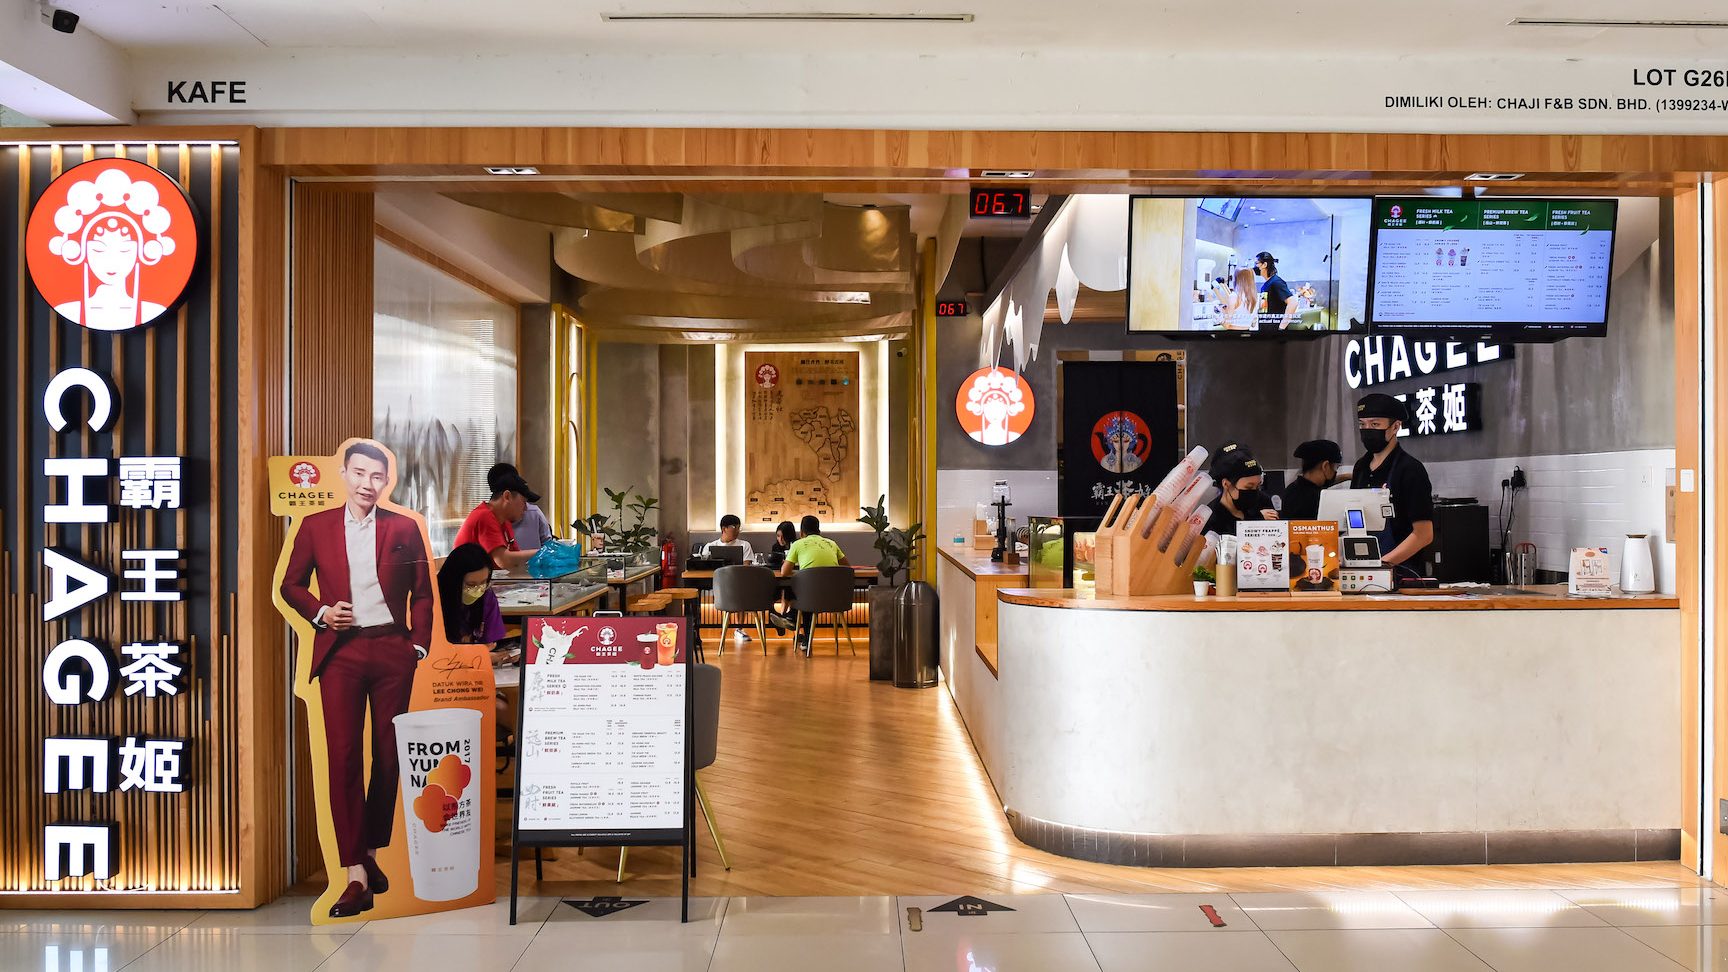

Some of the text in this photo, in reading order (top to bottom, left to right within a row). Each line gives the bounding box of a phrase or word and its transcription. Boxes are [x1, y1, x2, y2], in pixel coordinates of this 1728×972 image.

[1634, 69, 1728, 88] LOT G26
[168, 81, 246, 103] KAFE
[1385, 96, 1443, 108] DIMILIKI
[1448, 97, 1492, 109] OLEH:
[1497, 98, 1540, 109] CHAJI
[1545, 98, 1574, 110] F&B
[1578, 98, 1612, 111] SDN.
[1616, 98, 1651, 111] BHD.
[975, 193, 1023, 215] 067
[939, 303, 965, 315] 067
[43, 366, 111, 882] CHAGEE
[118, 457, 183, 792] 霸王茶姬
[408, 741, 460, 755] FROM
